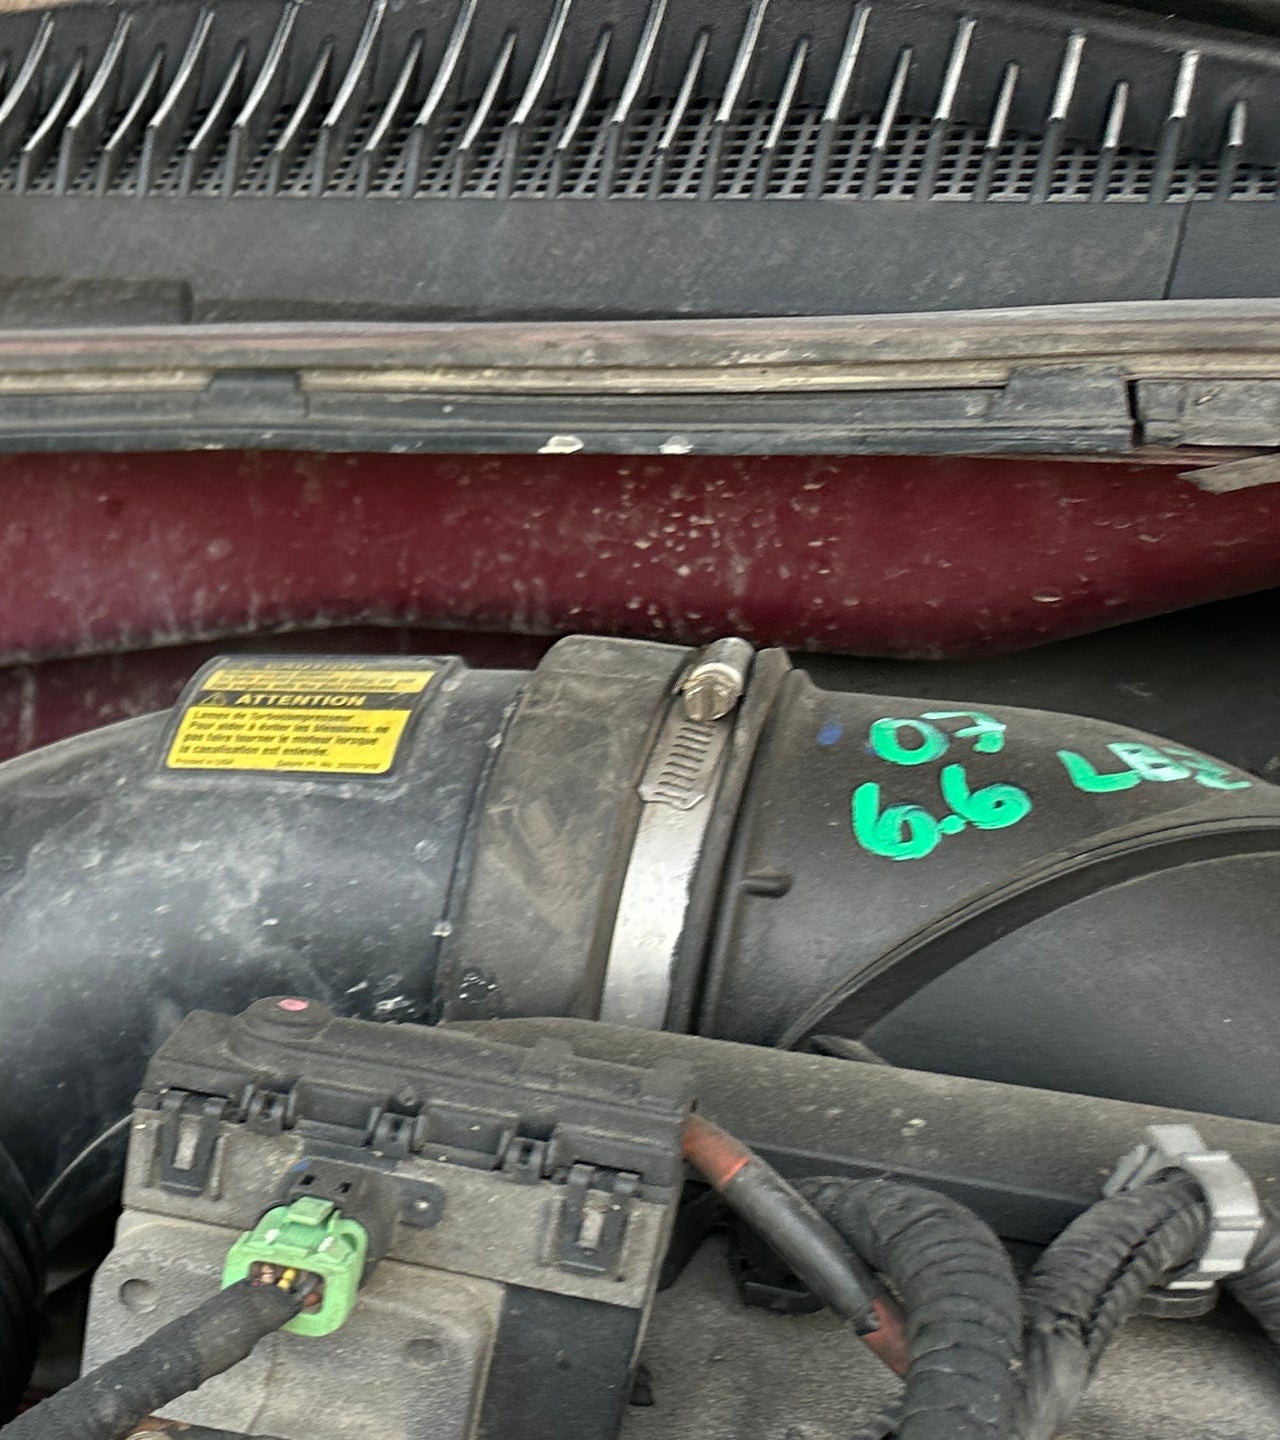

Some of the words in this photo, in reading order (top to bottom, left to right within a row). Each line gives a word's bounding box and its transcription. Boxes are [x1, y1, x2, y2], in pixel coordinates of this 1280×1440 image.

[233, 694, 368, 707] ATTENTION
[868, 711, 1007, 765] 07
[851, 763, 1033, 861] 6.6
